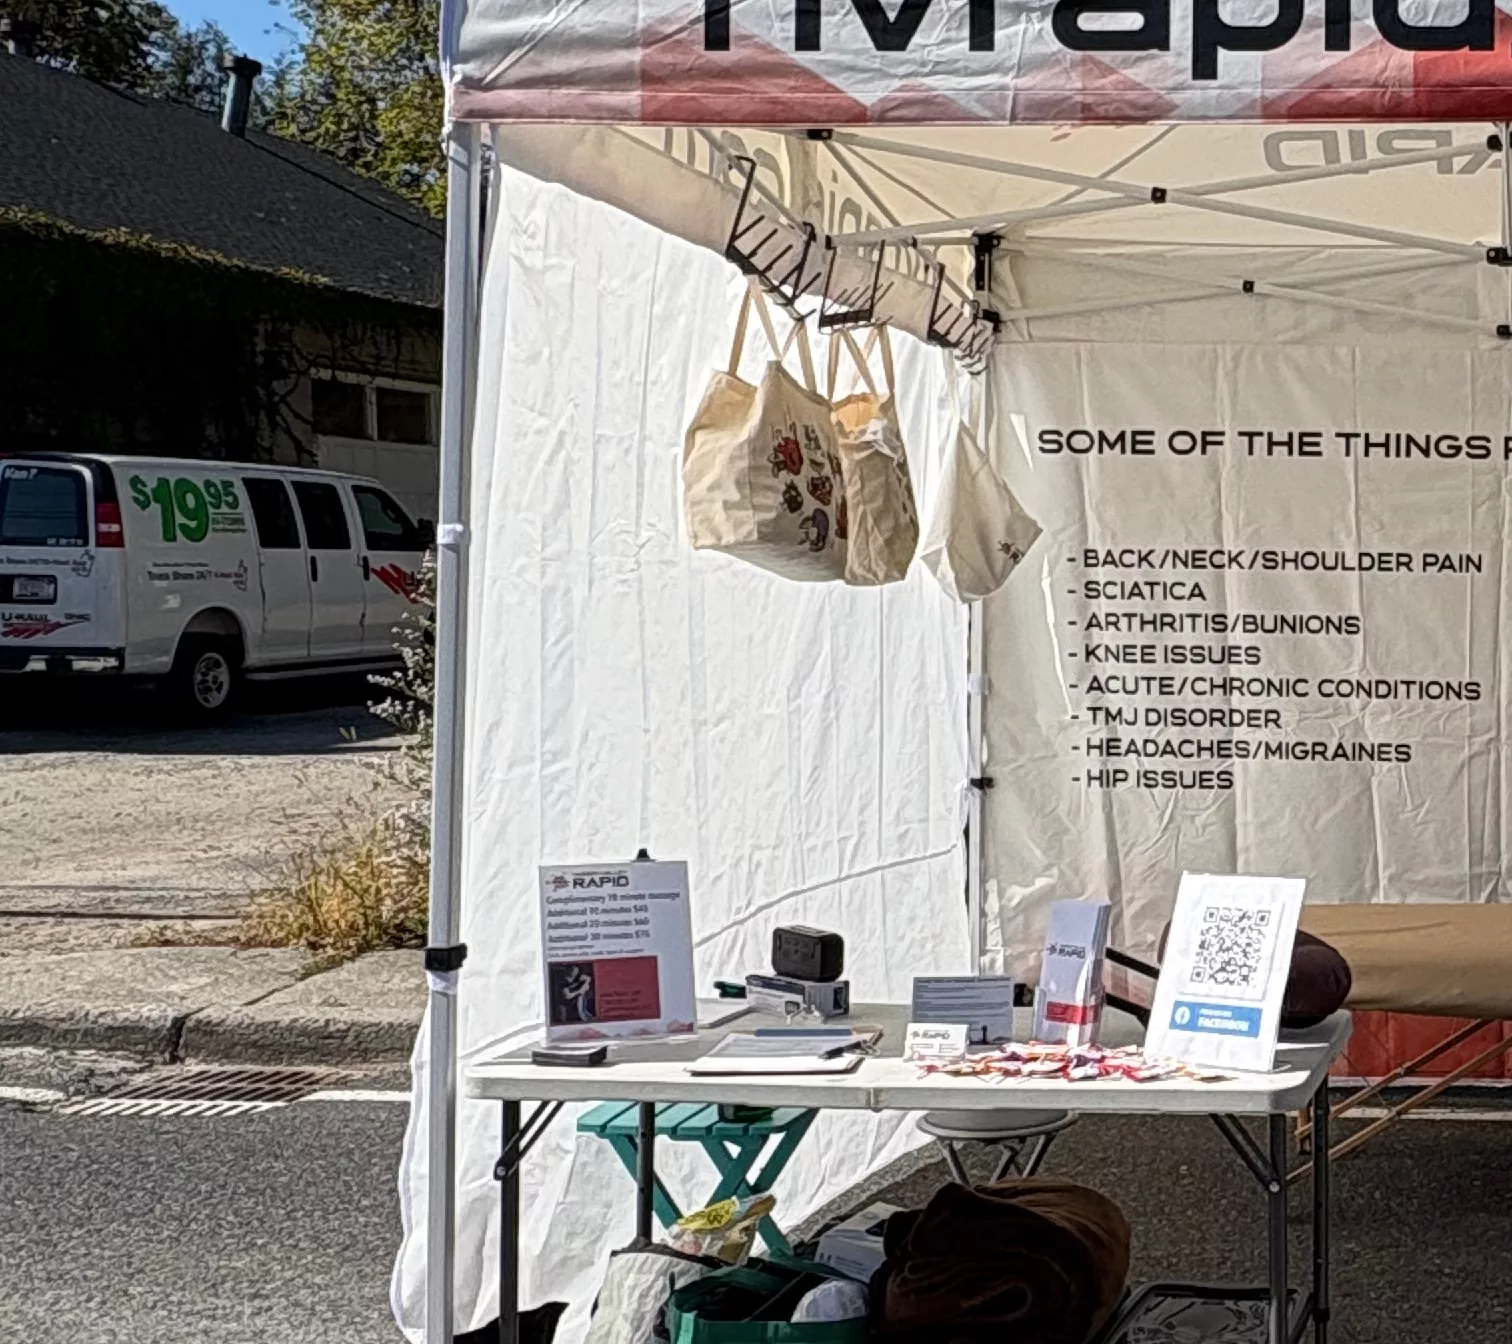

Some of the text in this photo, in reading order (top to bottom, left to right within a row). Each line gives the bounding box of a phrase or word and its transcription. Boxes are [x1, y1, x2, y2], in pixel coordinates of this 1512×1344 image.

[1039, 430, 1155, 455] SOME
[1169, 431, 1225, 455] OF
[1238, 431, 1322, 456] THE
[1335, 433, 1491, 459] THINGS
[1084, 549, 1481, 573] BACK/NECK/SHOULDER PAIN
[1085, 581, 1206, 601] SCIATICA
[1085, 613, 1360, 635] ARTHRITIS/BUNIONS
[1085, 644, 1260, 665] KNEE ISSUES
[1087, 676, 1480, 700] ACUTE/CHRONIC CONDITIONS
[1087, 707, 1281, 728] TMJ DISORDER
[1087, 738, 1411, 762] HEADACHES/MIGRAINES
[1087, 769, 1233, 789] HIP ISSUES
[572, 876, 630, 889] RAPID
